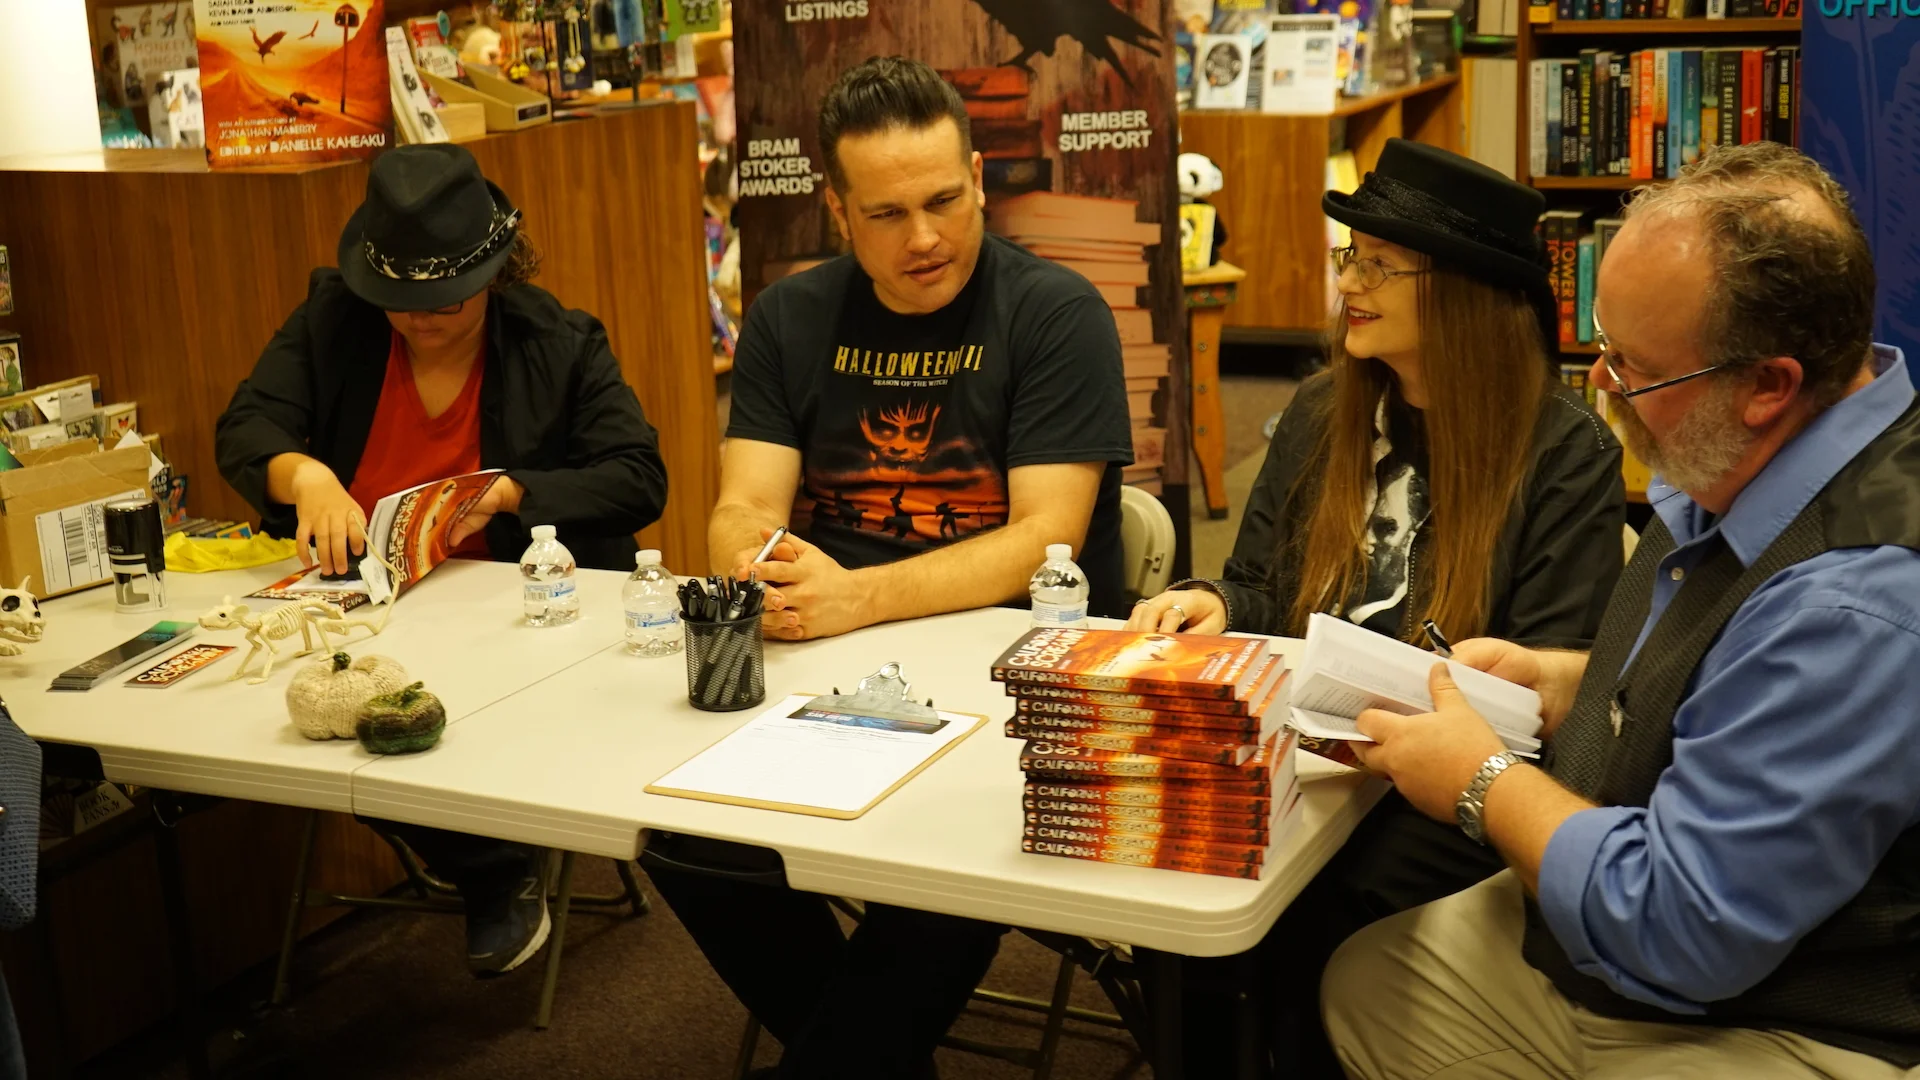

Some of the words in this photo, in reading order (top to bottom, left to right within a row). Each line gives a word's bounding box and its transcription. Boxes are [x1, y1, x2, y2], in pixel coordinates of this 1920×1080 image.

[785, 1, 870, 22] LISTINGS
[1062, 110, 1148, 131] MEMBER
[219, 126, 272, 140] JONATHAN
[1059, 130, 1153, 152] SUPPORT
[220, 145, 252, 157] EDITED
[270, 137, 324, 154] DANIELLE
[327, 133, 386, 150] KAHEAKU
[748, 138, 800, 158] BRAM
[739, 157, 812, 177] STOKER
[833, 345, 959, 377] HALLOWEEN
[872, 379, 900, 387] SEASON
